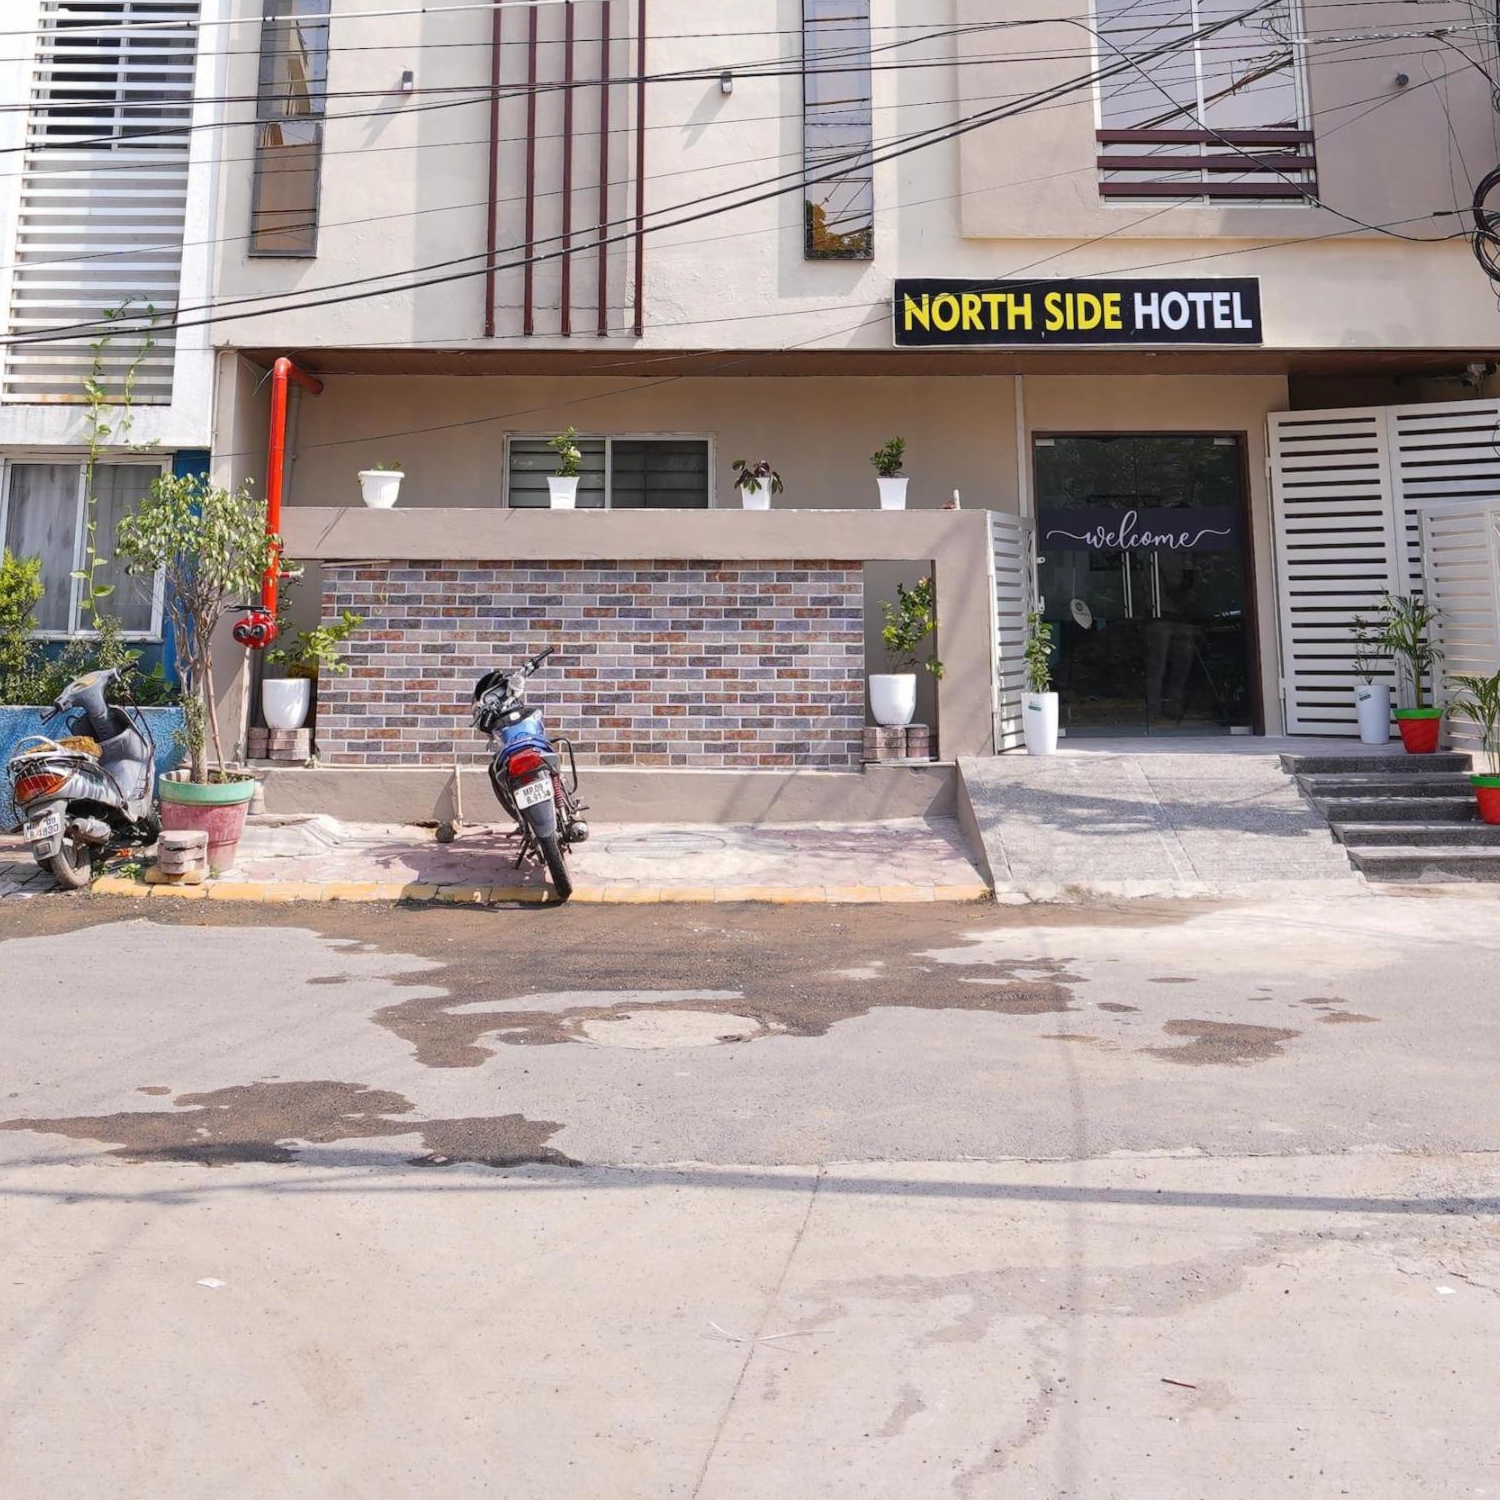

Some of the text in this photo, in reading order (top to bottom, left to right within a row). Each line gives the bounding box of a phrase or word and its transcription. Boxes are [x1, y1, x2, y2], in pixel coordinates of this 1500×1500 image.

[904, 291, 1253, 332] NORTH SIDE HOTEL
[1046, 510, 1231, 549] welcome
